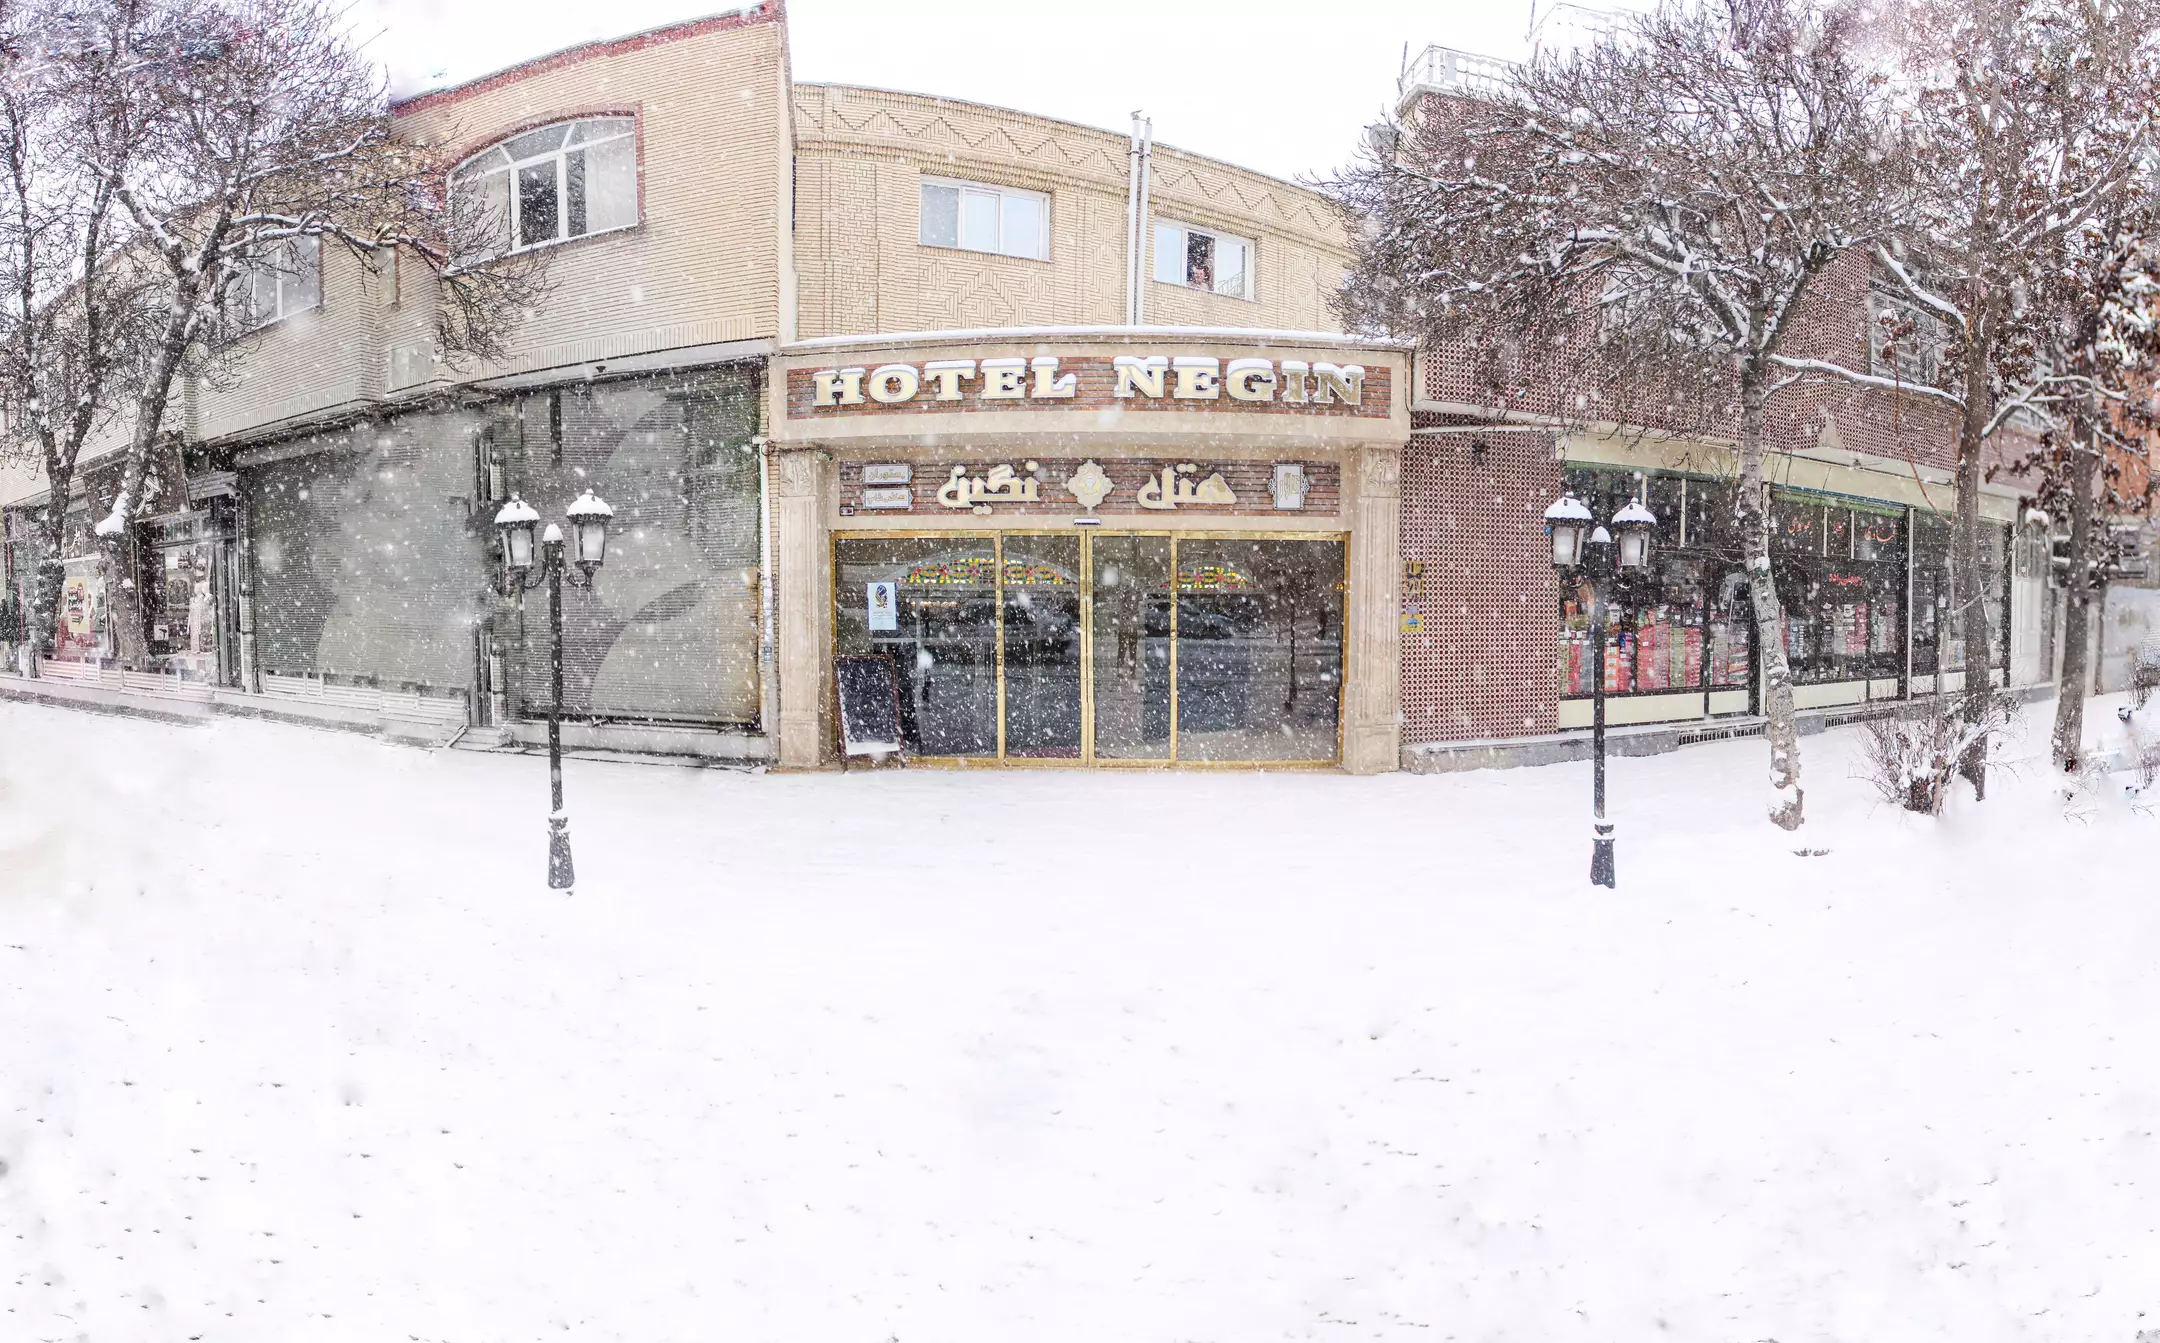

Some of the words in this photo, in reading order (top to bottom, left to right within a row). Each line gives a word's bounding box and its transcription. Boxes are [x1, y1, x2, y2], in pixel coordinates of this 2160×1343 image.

[813, 357, 1077, 407] HOTEL
[1113, 356, 1366, 406] NEGIN
[936, 460, 1041, 516] نگین
[1137, 463, 1238, 510] هتل
